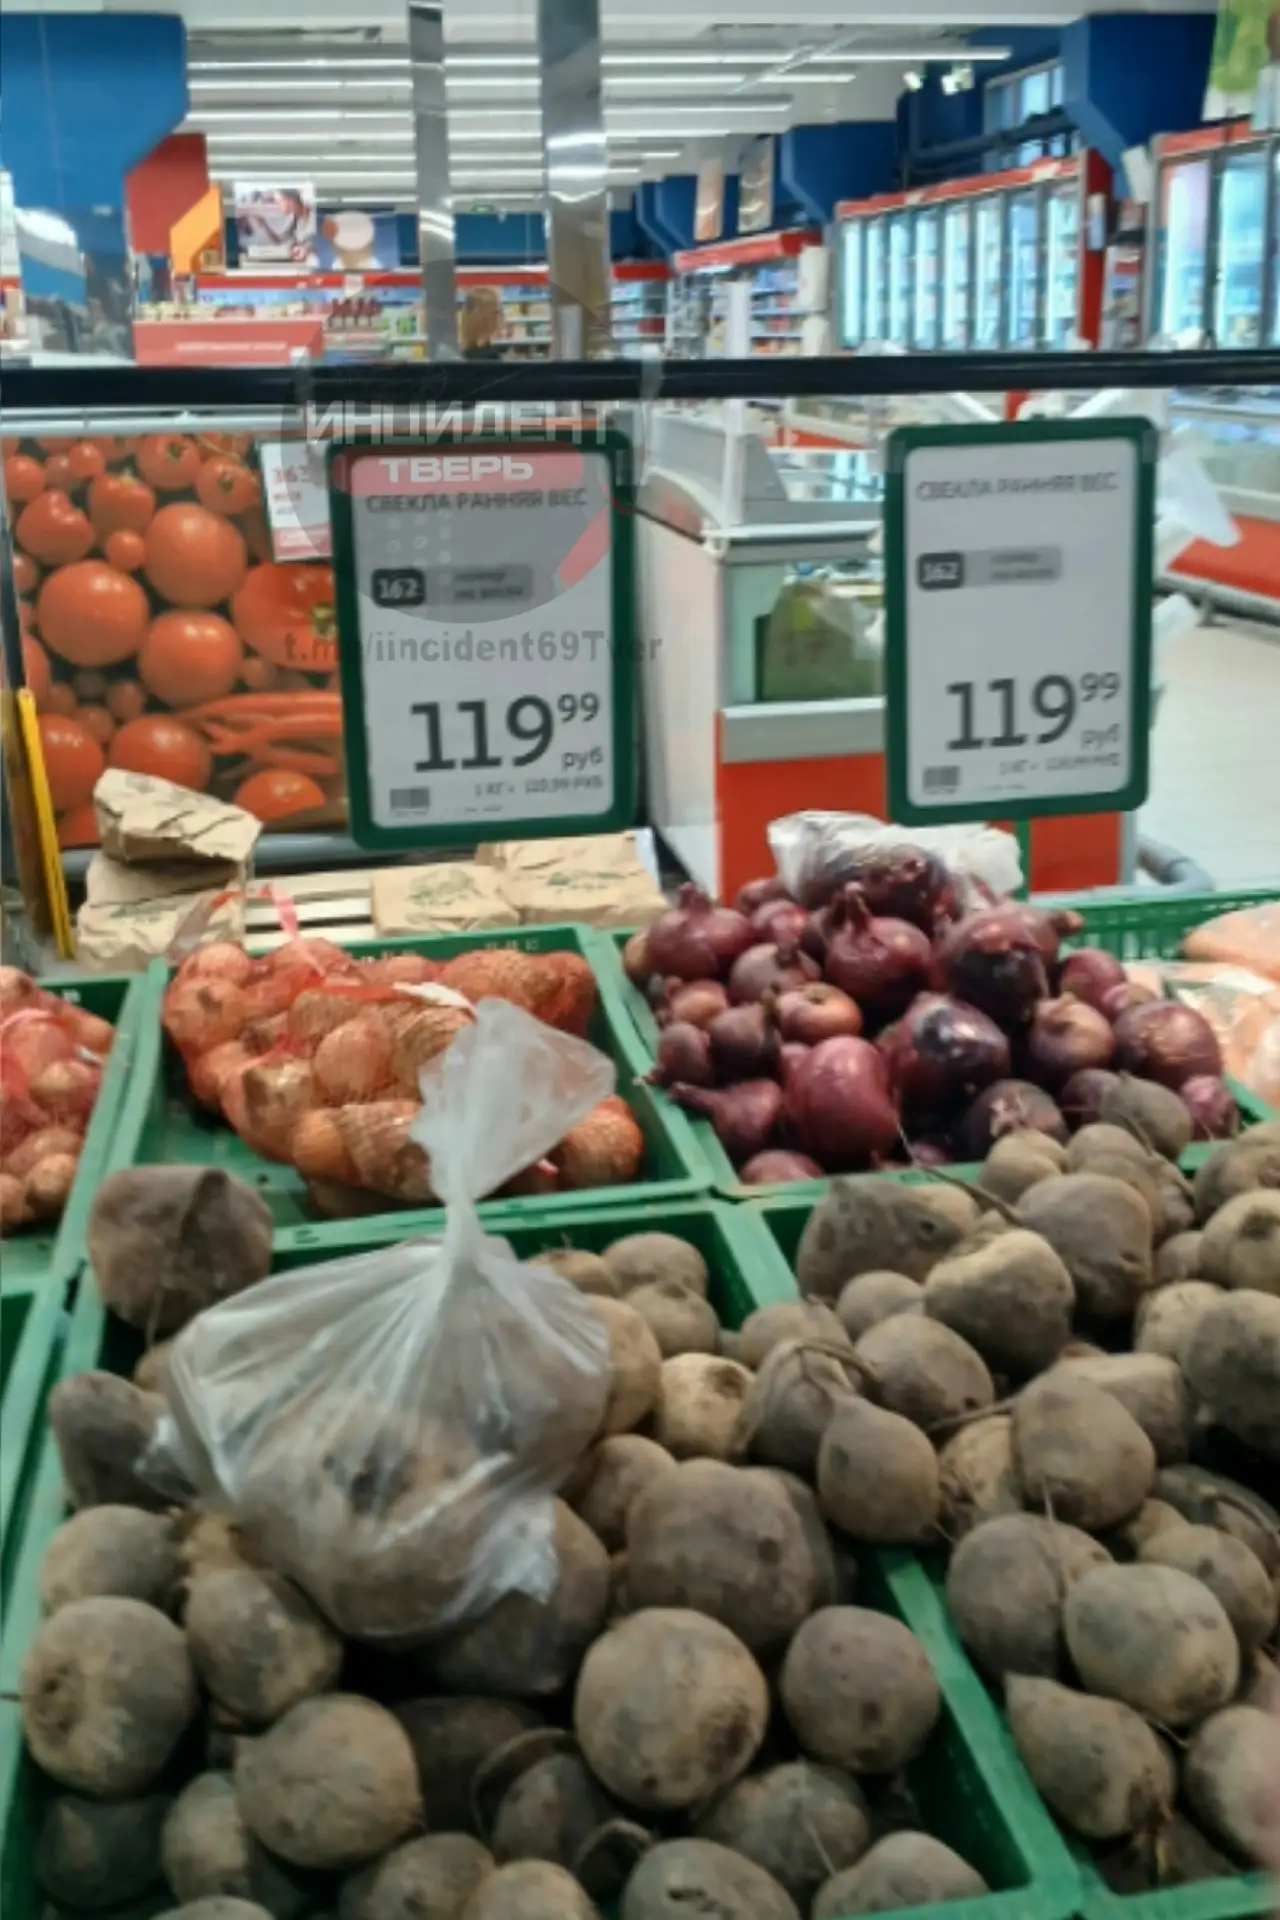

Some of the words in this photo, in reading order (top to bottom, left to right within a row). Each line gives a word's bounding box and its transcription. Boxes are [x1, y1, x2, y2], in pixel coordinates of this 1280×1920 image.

[411, 695, 555, 772] 119
[557, 692, 600, 723] 99
[945, 674, 1076, 751] 119
[1080, 672, 1121, 702] 99
[562, 746, 604, 771] руб
